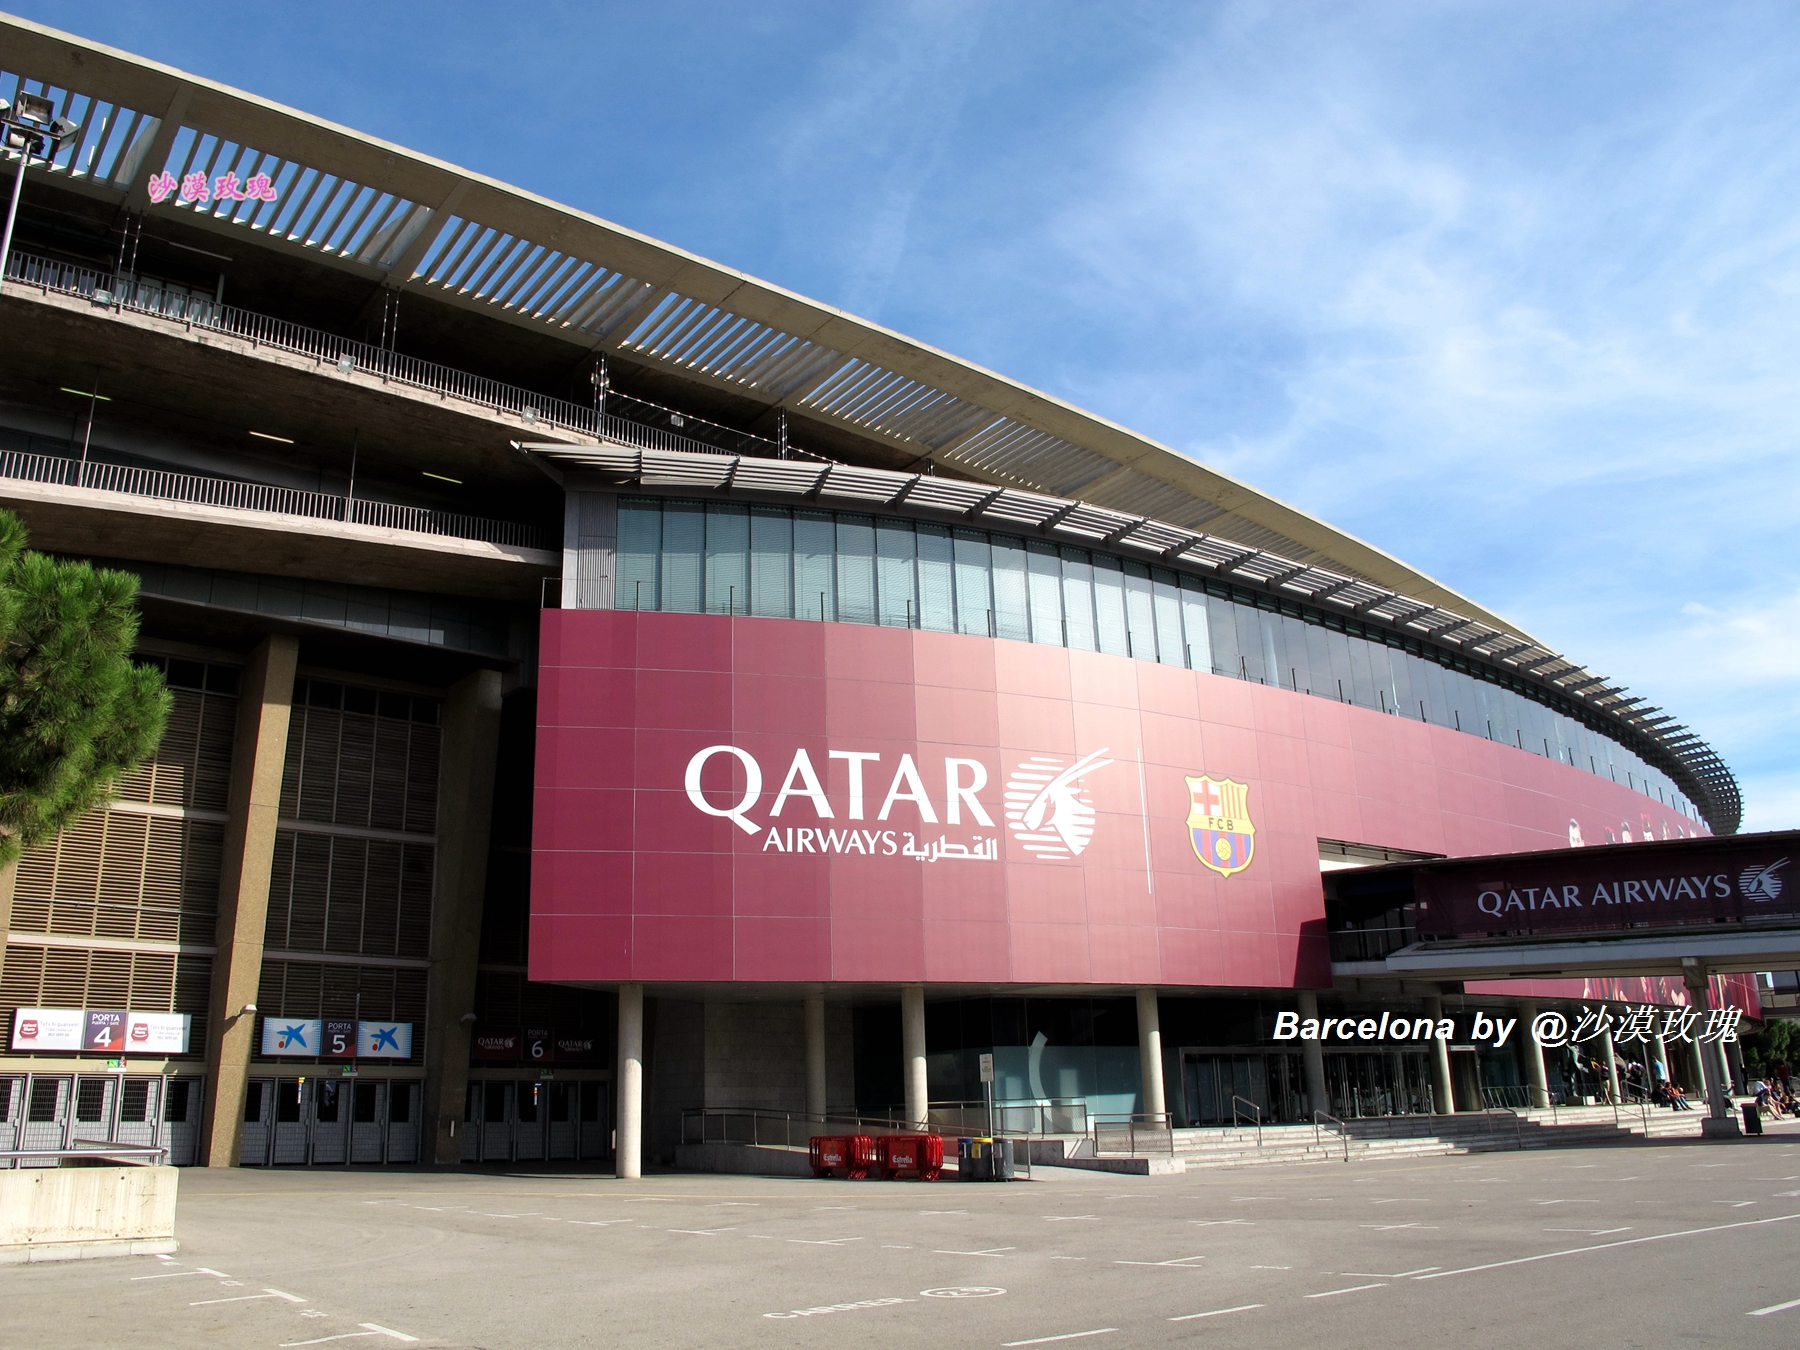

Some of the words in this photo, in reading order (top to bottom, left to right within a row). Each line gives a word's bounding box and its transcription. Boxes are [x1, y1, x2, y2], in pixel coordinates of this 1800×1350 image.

[684, 745, 996, 835] QATAR
[762, 826, 898, 855] AIRWAYS
[902, 831, 998, 862] القطرية
[1477, 884, 1583, 917] QATAR
[1591, 874, 1732, 906] AIRWAYS
[92, 1013, 120, 1022] PORTA
[328, 1022, 352, 1030] PORTA
[527, 1029, 549, 1037] PORTA
[93, 1026, 112, 1048] 4
[332, 1034, 346, 1054] 5
[478, 1037, 504, 1046] QATAR
[558, 1039, 583, 1048] QATAR
[531, 1040, 544, 1058] 6
[823, 1153, 842, 1162] Estrella
[892, 1154, 913, 1164] Estrella
